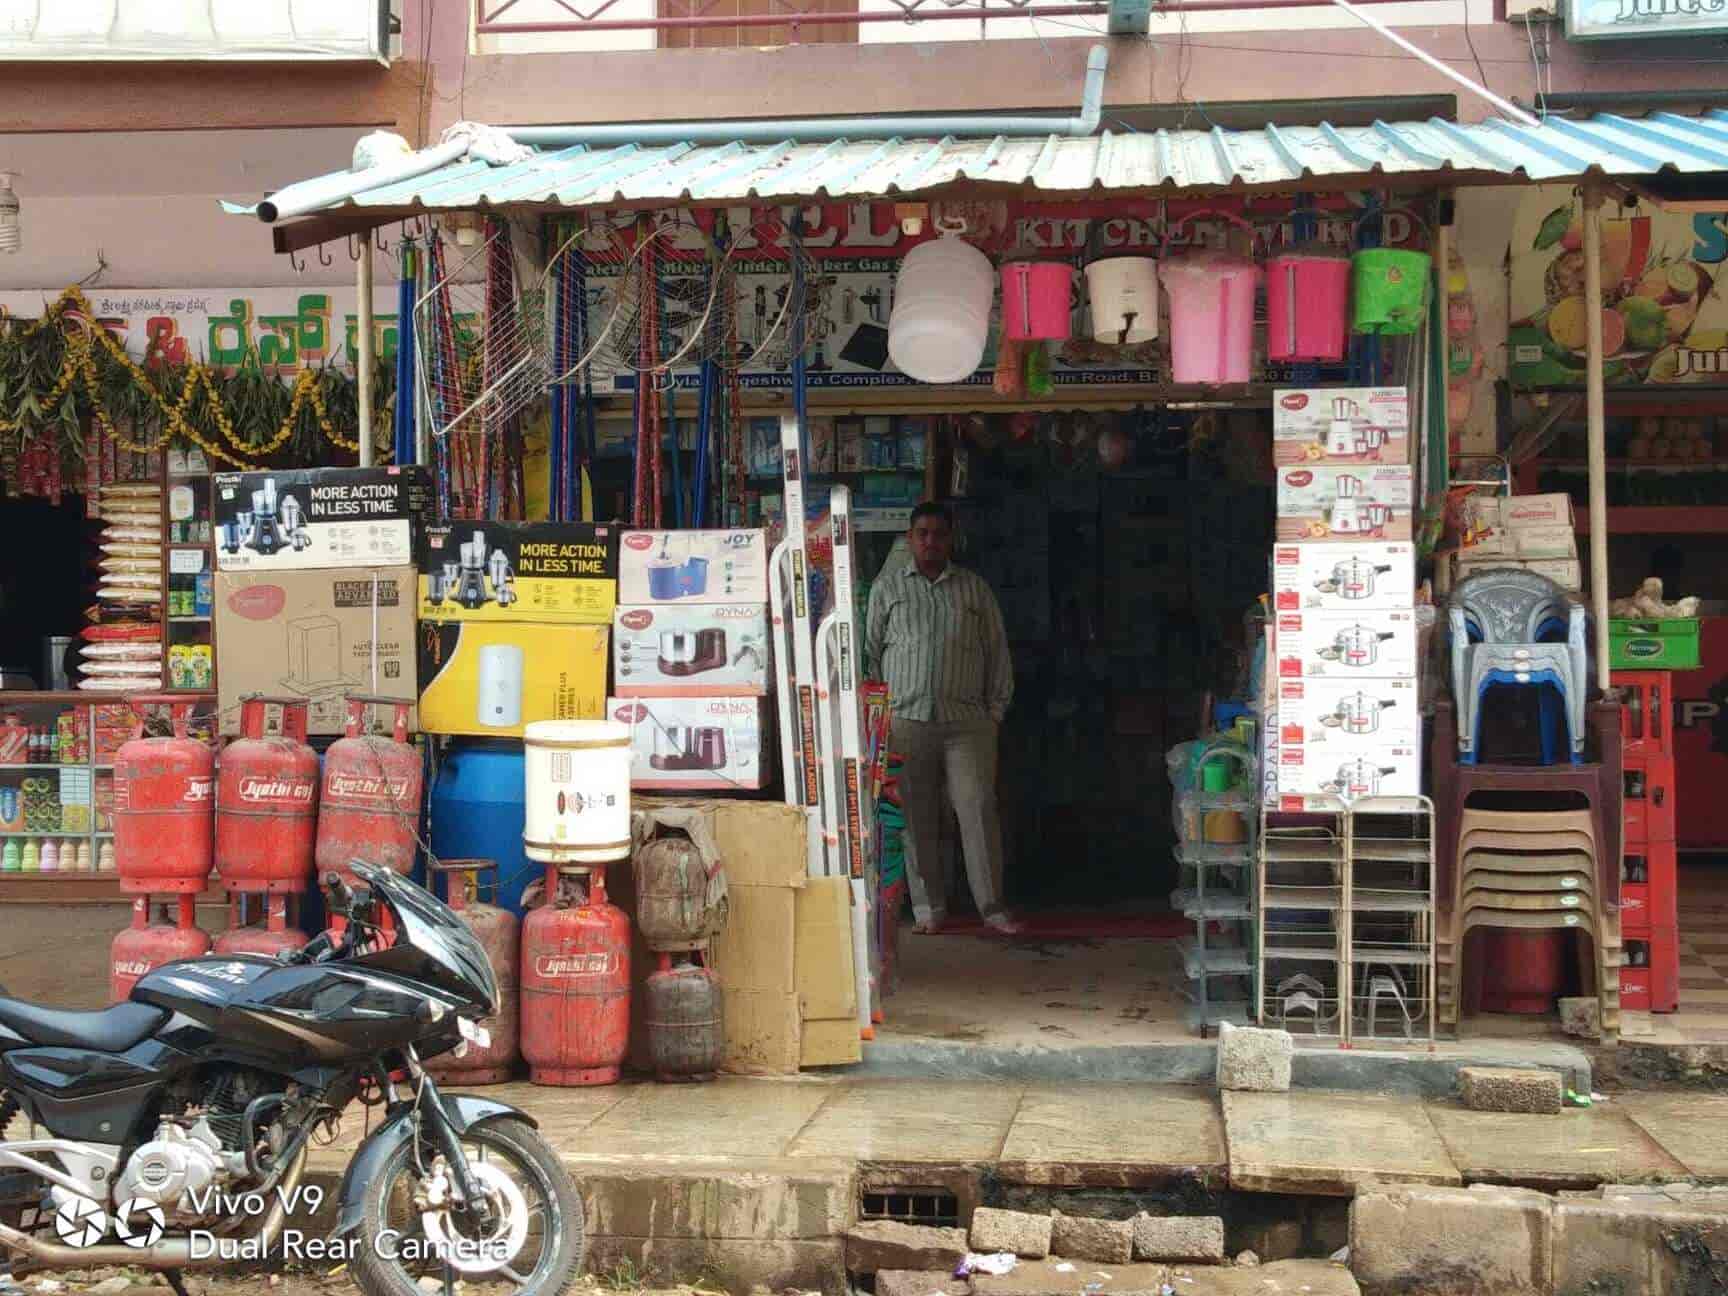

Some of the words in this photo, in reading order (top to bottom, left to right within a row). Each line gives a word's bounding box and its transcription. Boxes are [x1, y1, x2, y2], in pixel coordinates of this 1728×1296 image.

[310, 485, 349, 502] MORE
[351, 483, 399, 500] ACTION
[310, 502, 326, 515] IN
[328, 501, 361, 515] LESS
[723, 534, 755, 545] JOY
[520, 543, 557, 557] MORE
[559, 544, 607, 558] ACTION
[519, 559, 534, 572] IN
[536, 559, 568, 573] LESS
